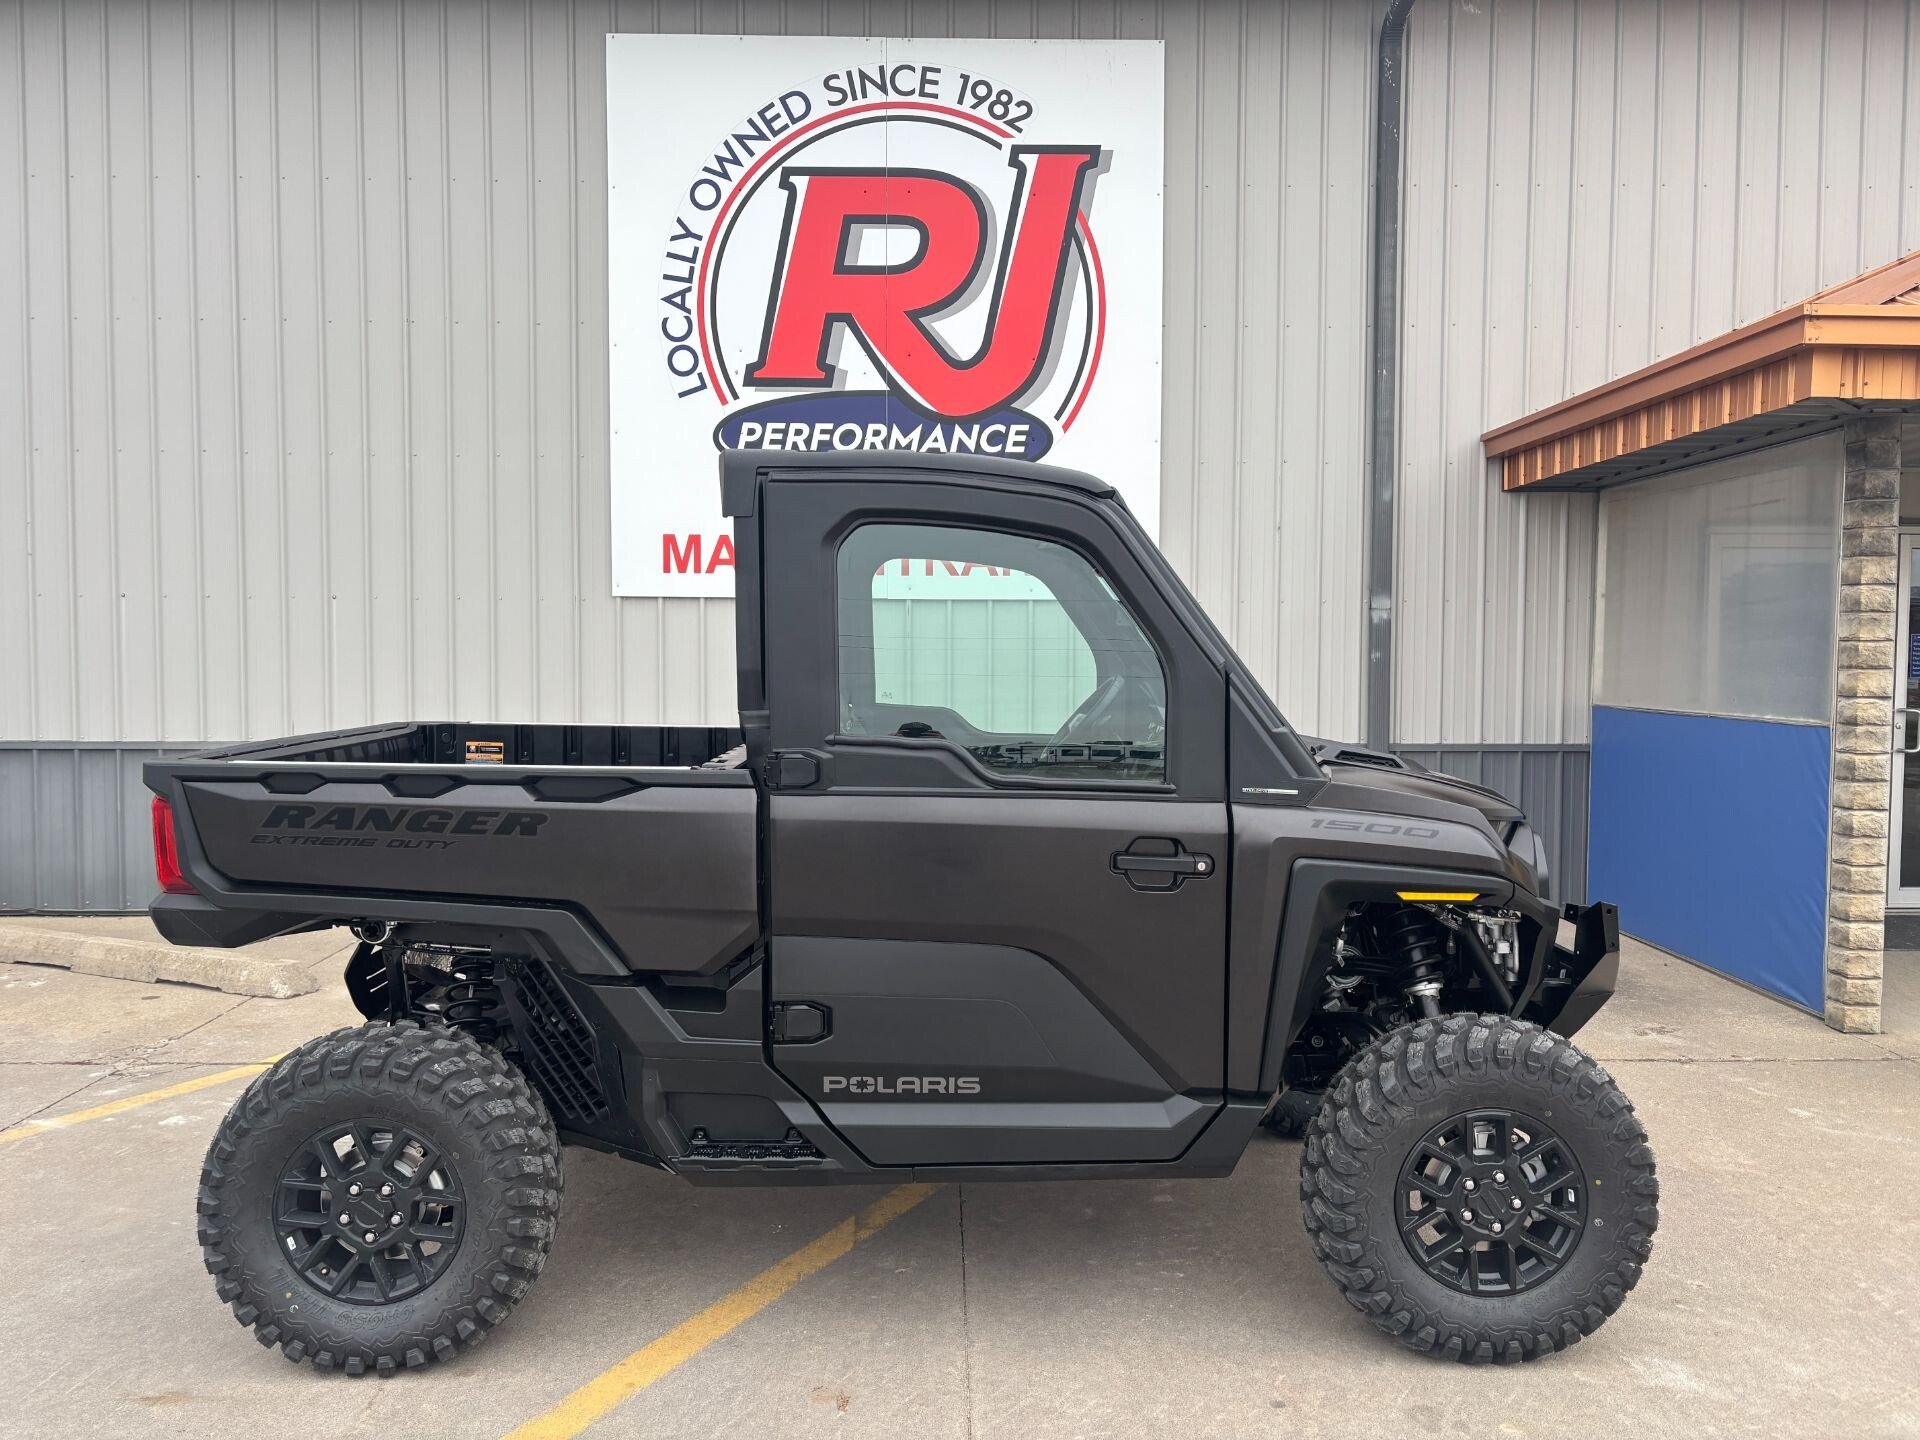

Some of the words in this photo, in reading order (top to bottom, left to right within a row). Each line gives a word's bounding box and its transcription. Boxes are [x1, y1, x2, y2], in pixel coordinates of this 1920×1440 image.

[661, 217, 708, 399] LOCALLY
[690, 90, 812, 211] OWNED
[823, 64, 941, 107] SINCE
[959, 73, 1034, 133] 1982
[743, 144, 1108, 417] RJ
[738, 422, 1030, 454] PERFORMANCE
[662, 533, 735, 574] MA
[260, 804, 549, 837] RANGER
[1311, 818, 1440, 839] 1500
[249, 834, 378, 848] EXTREME
[385, 837, 460, 850] DUTY
[823, 1076, 981, 1094] POLARIS
